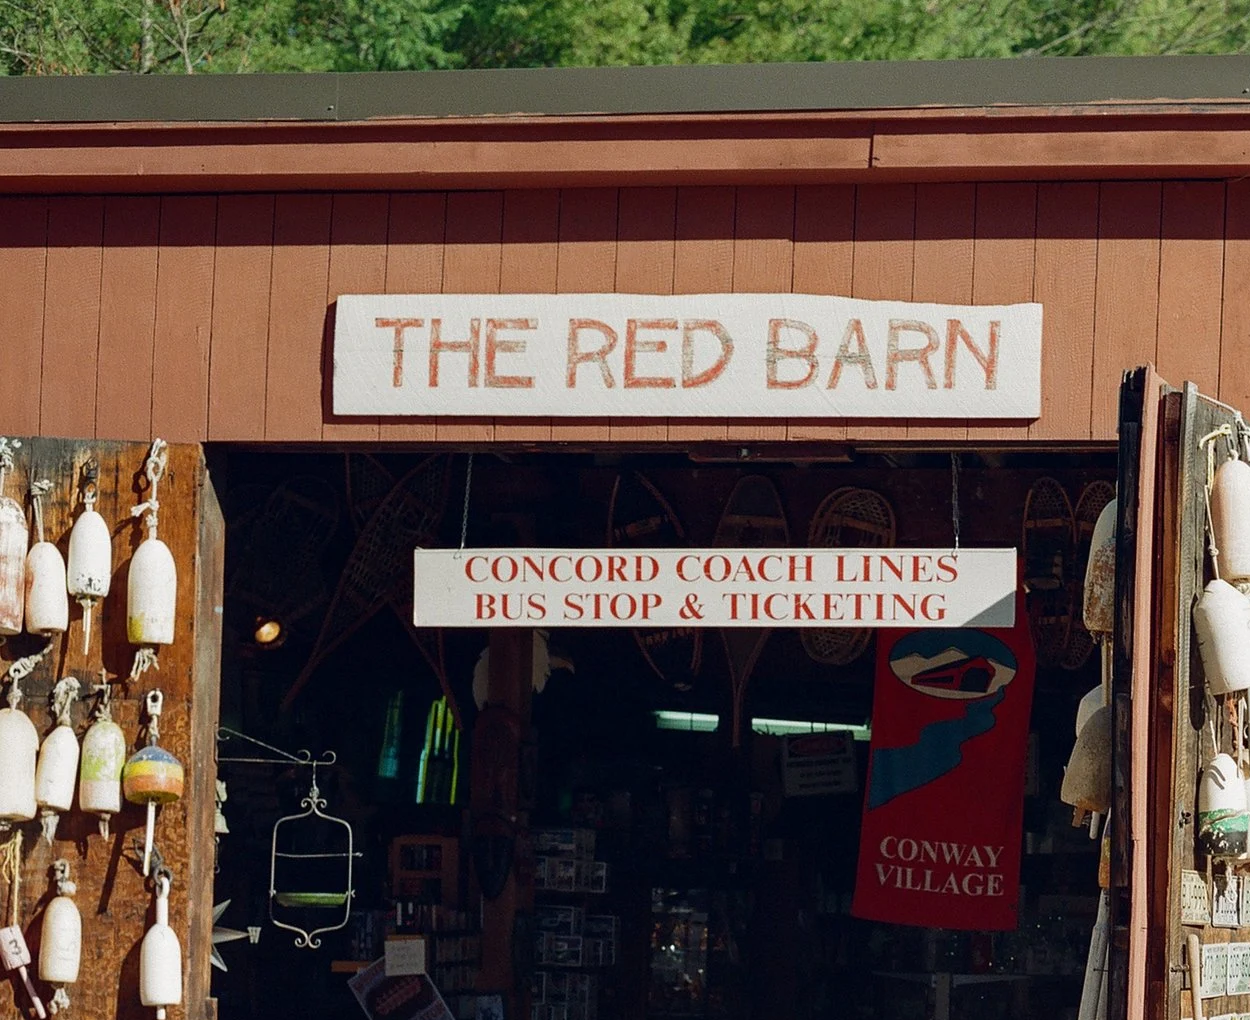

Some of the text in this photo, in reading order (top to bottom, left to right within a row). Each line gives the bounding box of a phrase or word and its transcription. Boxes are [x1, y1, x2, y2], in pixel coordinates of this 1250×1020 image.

[375, 317, 1001, 391] THE RED BARN
[464, 554, 960, 584] CONCORD COACH LINES
[474, 592, 948, 622] BUS STOP & TICKETING
[880, 836, 1005, 868] CONWAY
[876, 864, 1004, 897] VILLAGE
[8, 938, 22, 956] 3
